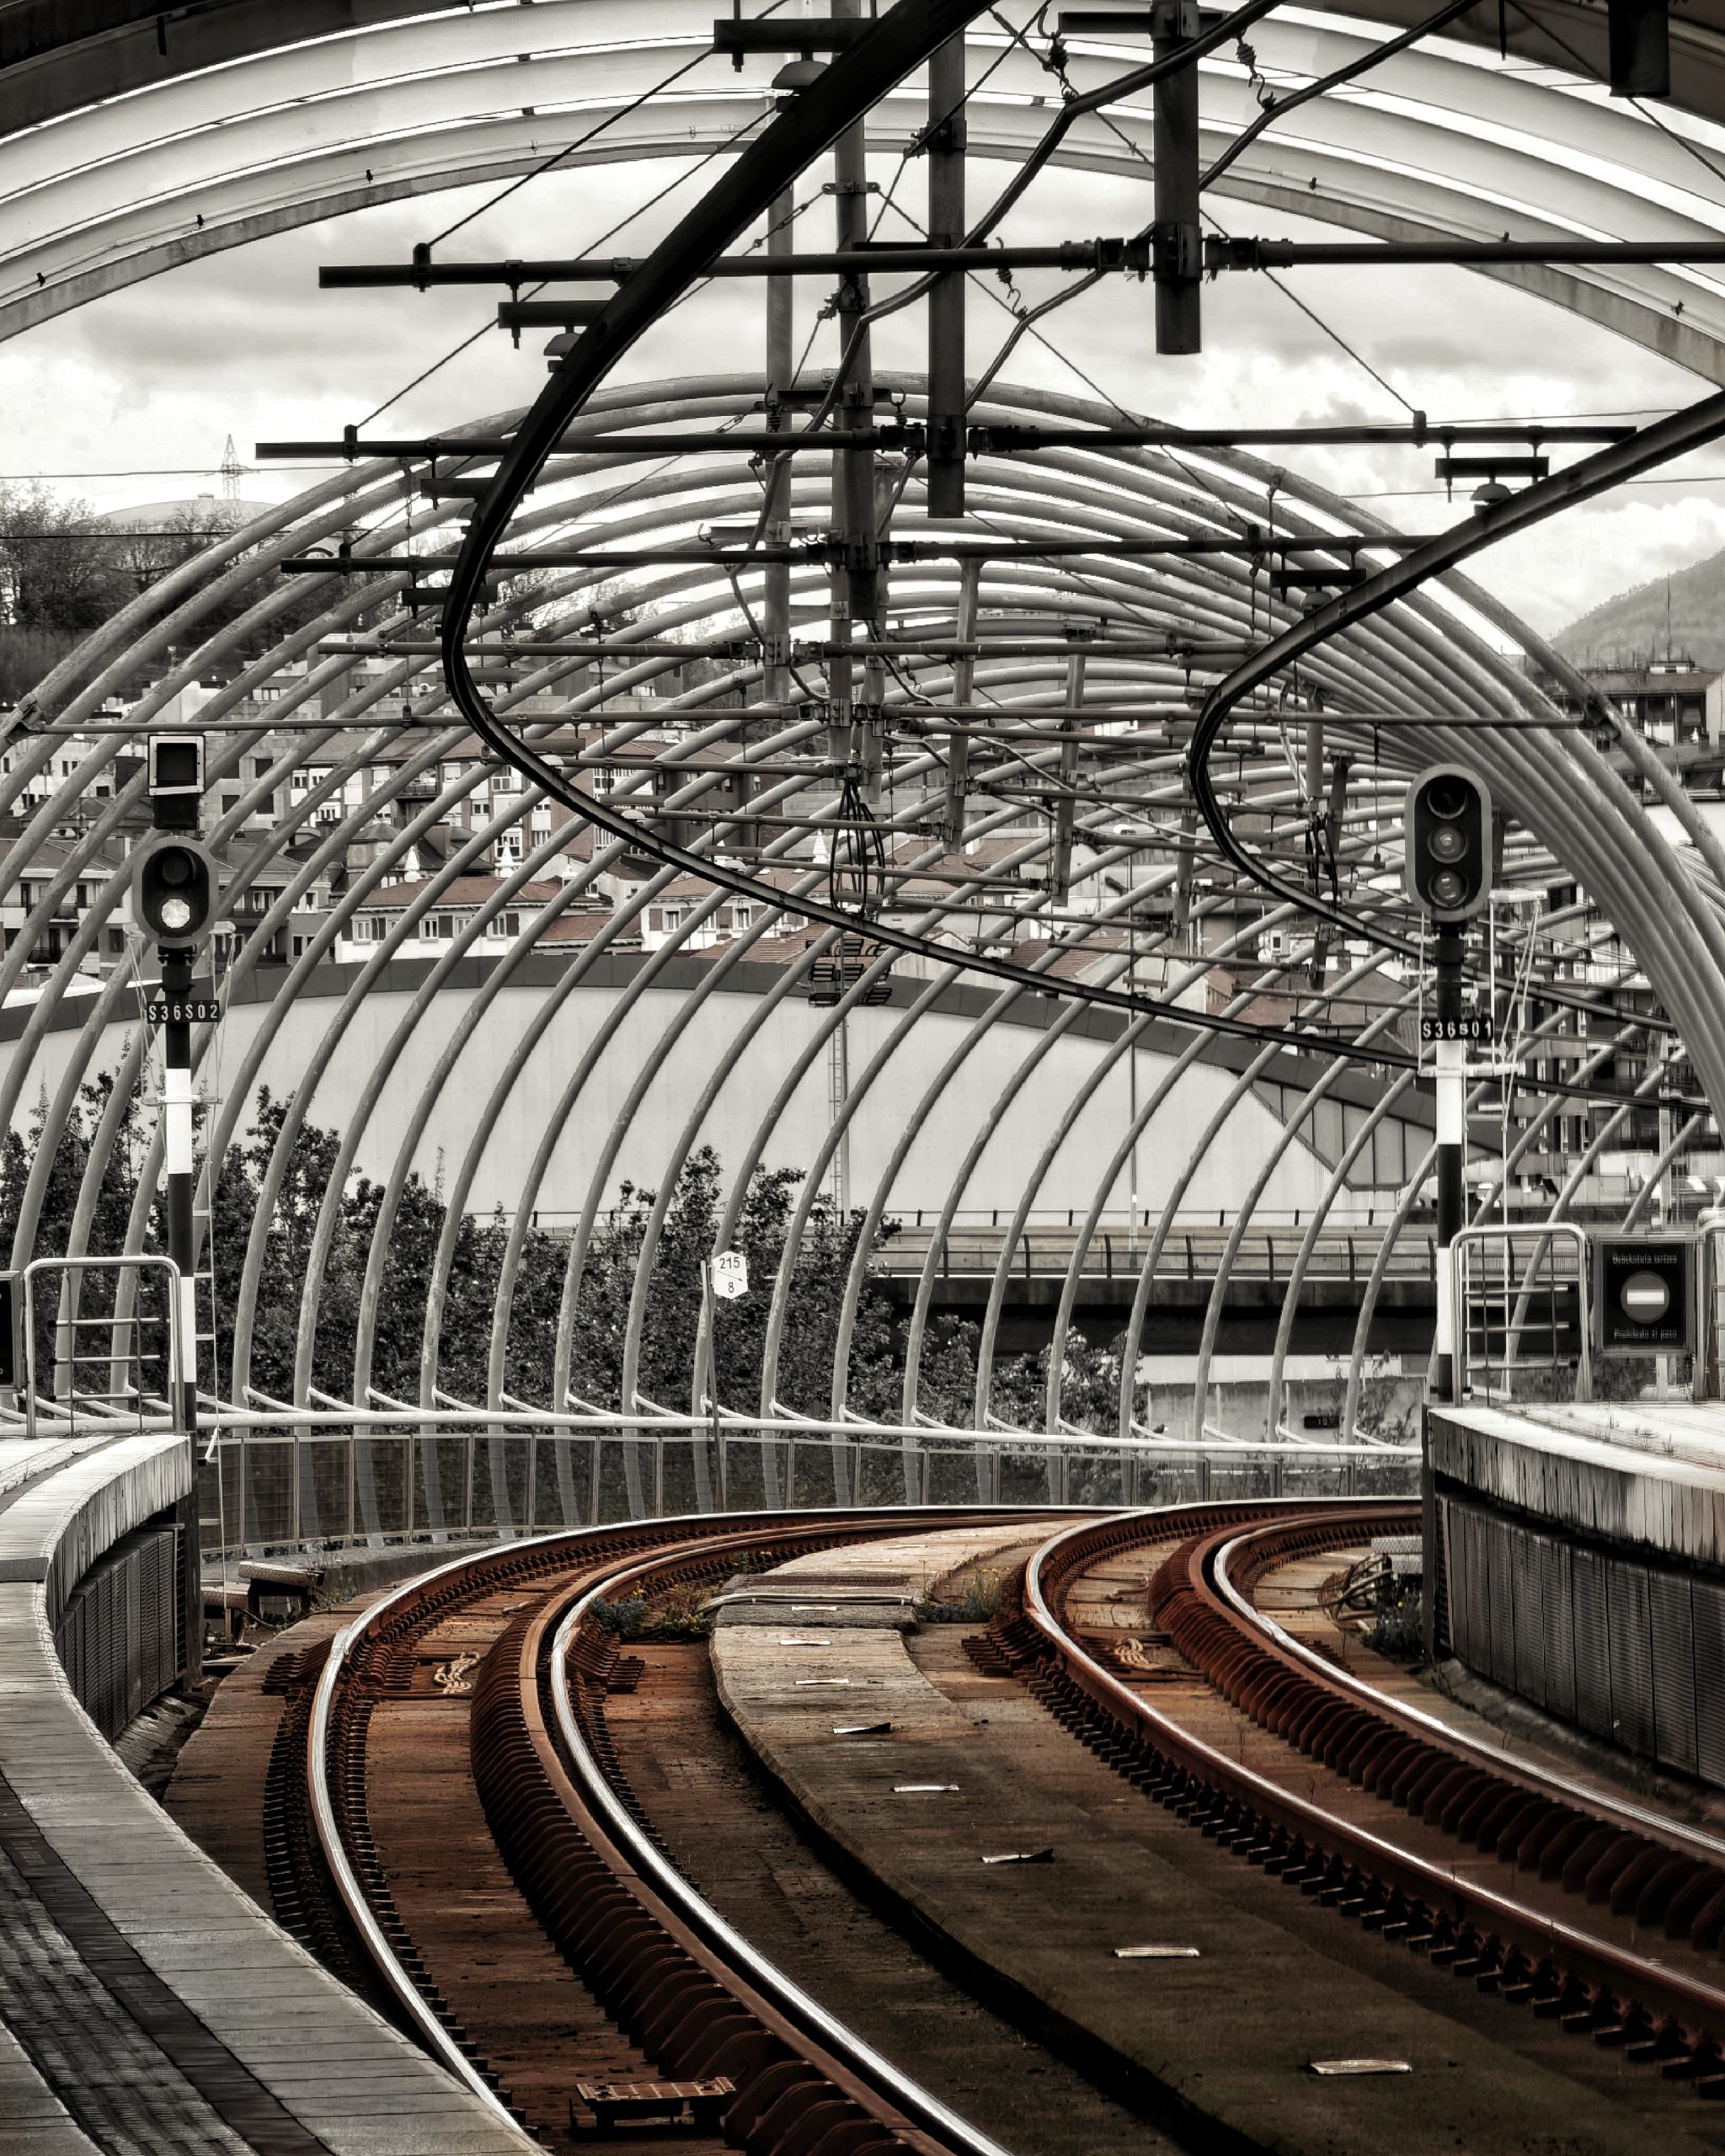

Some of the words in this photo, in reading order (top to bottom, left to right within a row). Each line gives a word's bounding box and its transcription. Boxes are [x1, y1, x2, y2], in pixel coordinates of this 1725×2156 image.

[148, 1004, 218, 1021] S36S02
[719, 1257, 740, 1269] 215
[728, 1281, 734, 1294] 8
[1660, 1329, 1677, 1341] paso
